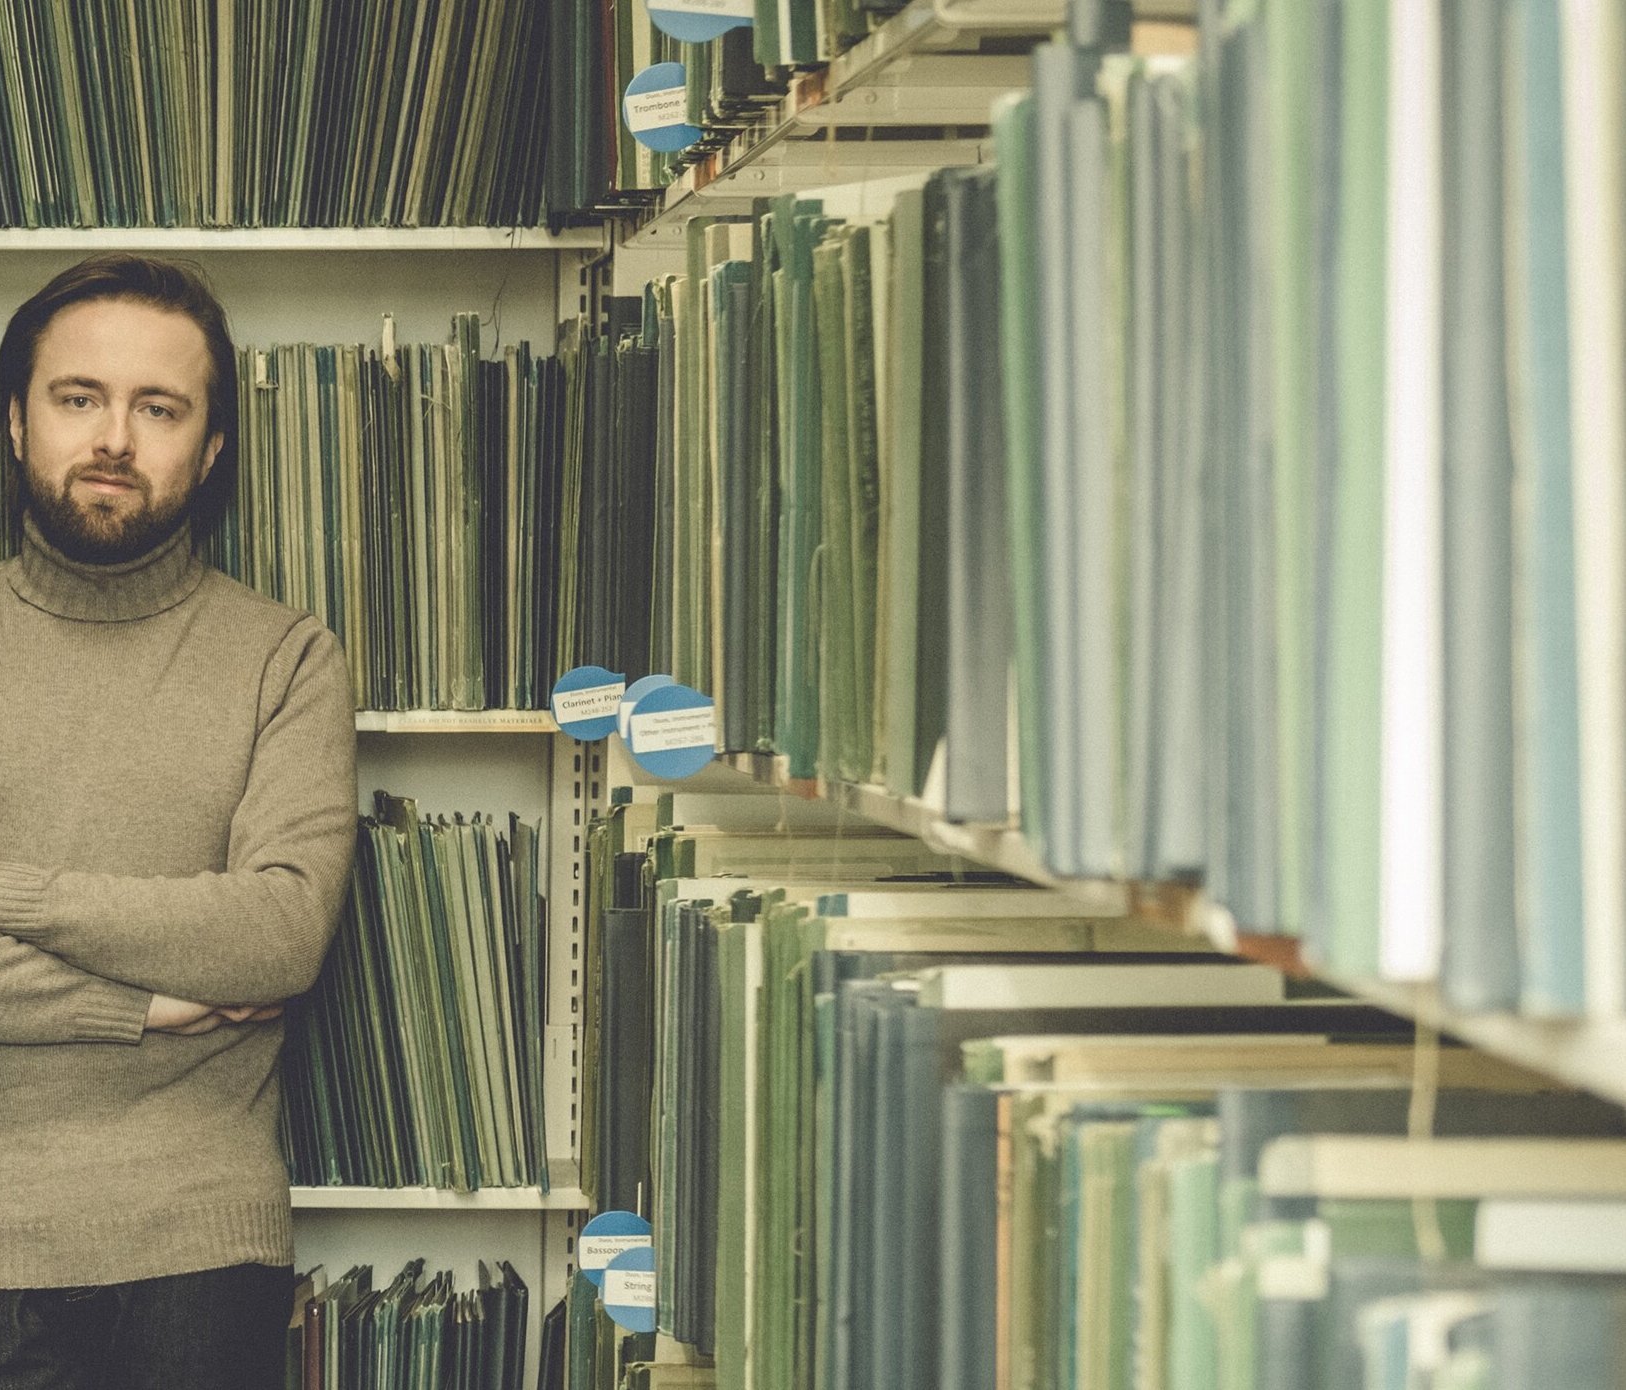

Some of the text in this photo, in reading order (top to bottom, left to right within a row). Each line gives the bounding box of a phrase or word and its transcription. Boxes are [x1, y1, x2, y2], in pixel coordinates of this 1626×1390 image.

[633, 100, 680, 113] Trombone
[562, 698, 596, 709] Clarinet
[624, 1281, 652, 1293] String
